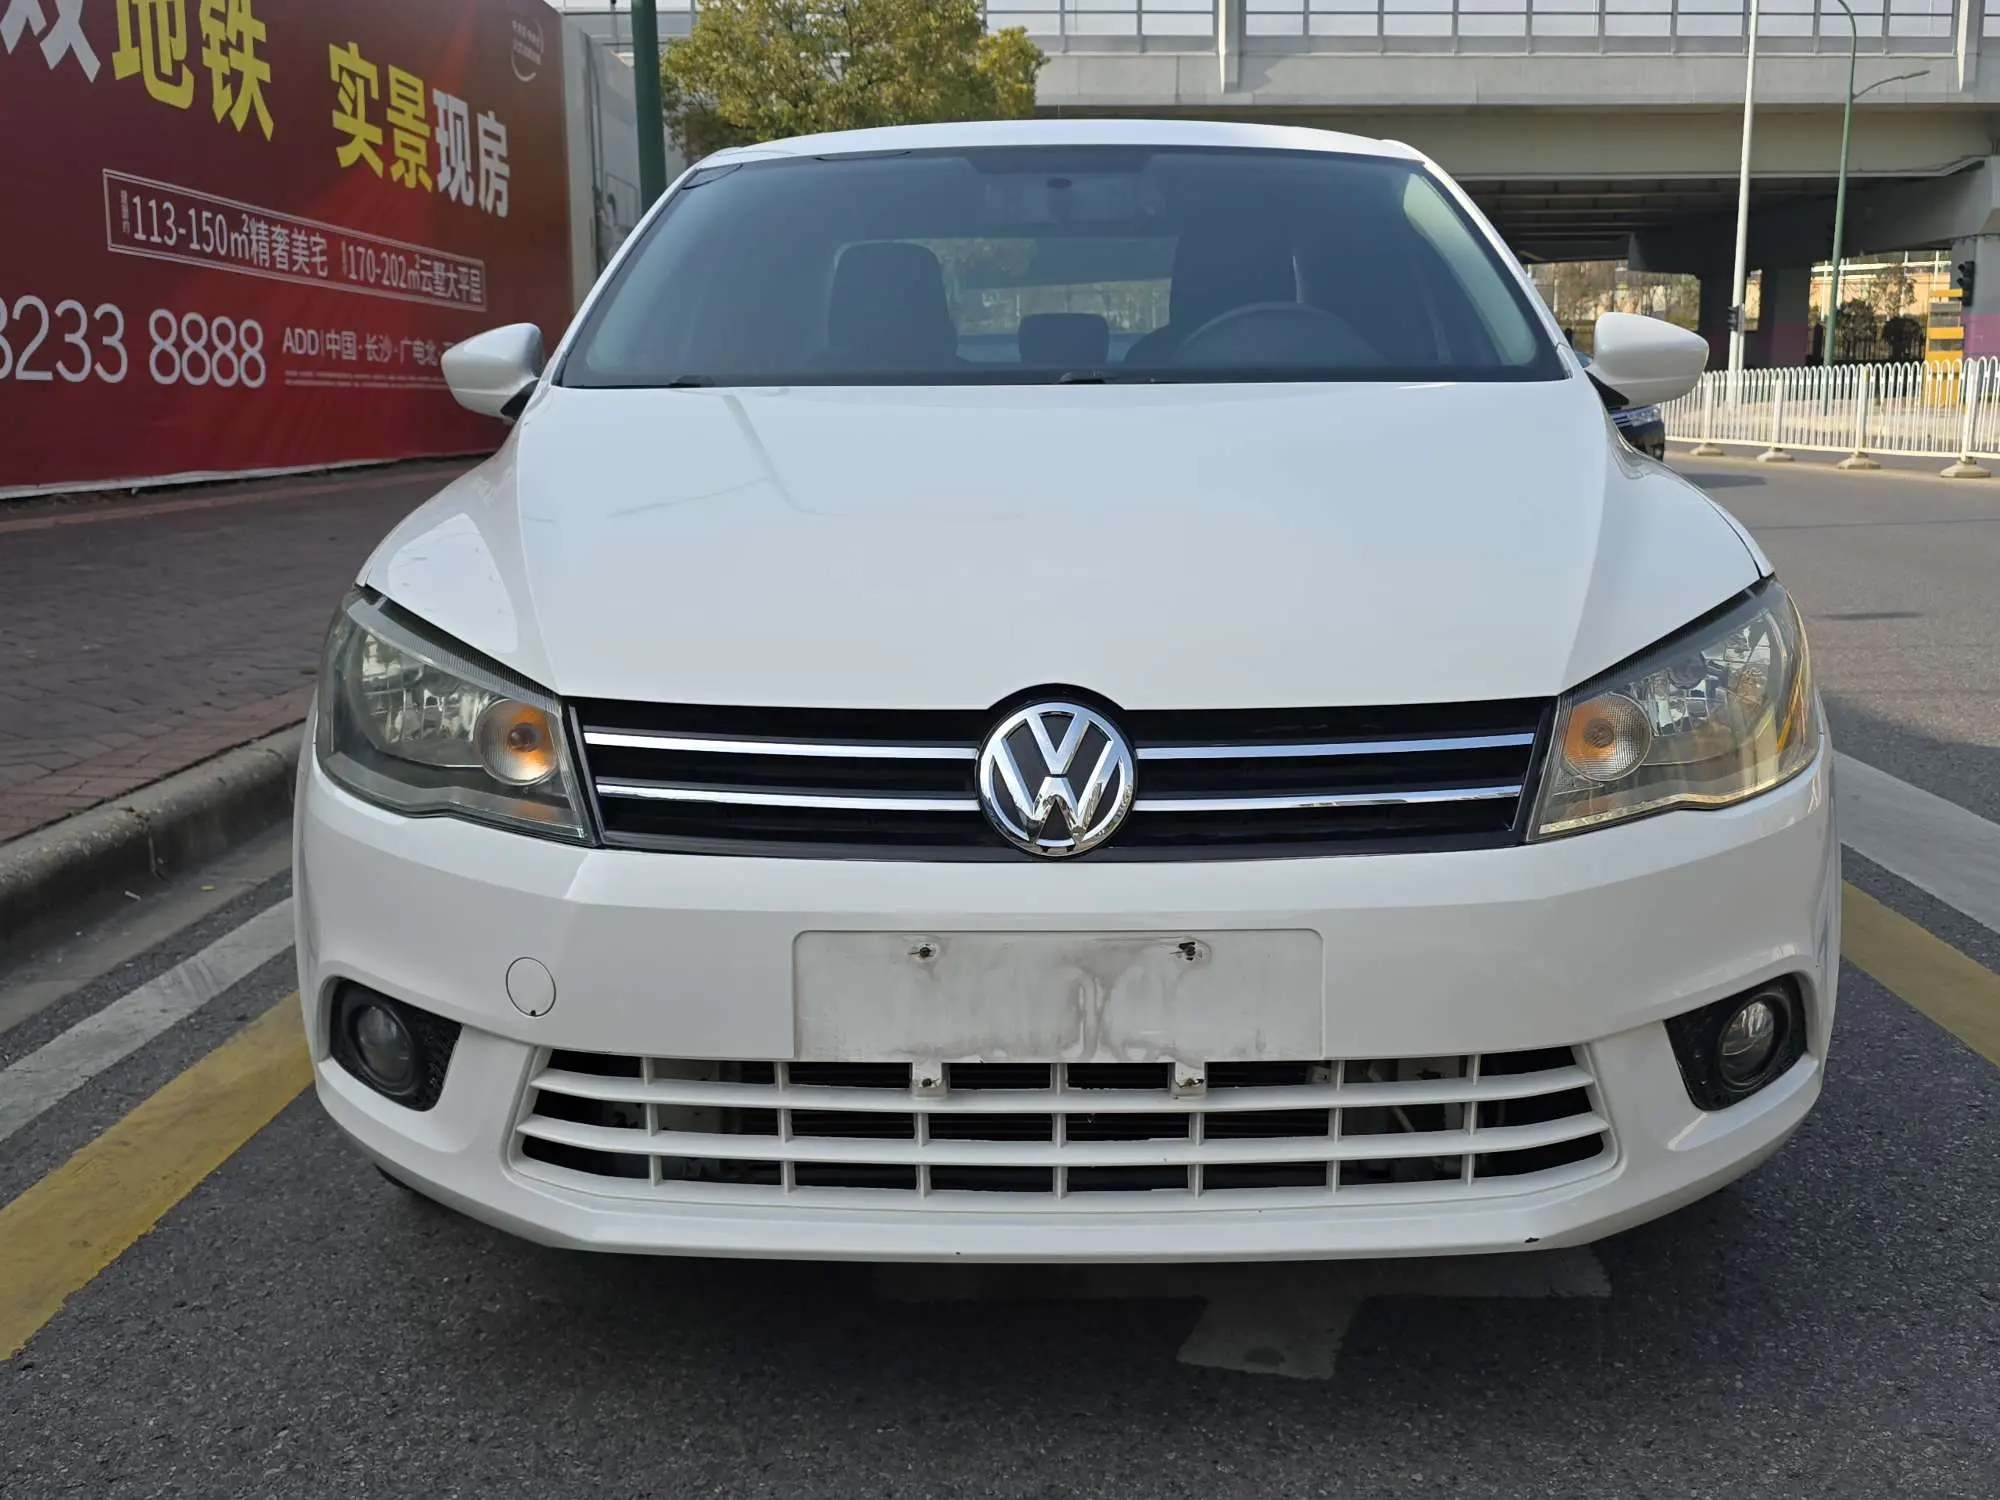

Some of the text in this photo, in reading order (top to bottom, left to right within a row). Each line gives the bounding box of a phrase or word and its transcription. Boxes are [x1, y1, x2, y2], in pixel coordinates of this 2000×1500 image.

[329, 41, 510, 218] 实景现房
[149, 308, 266, 388] 8888
